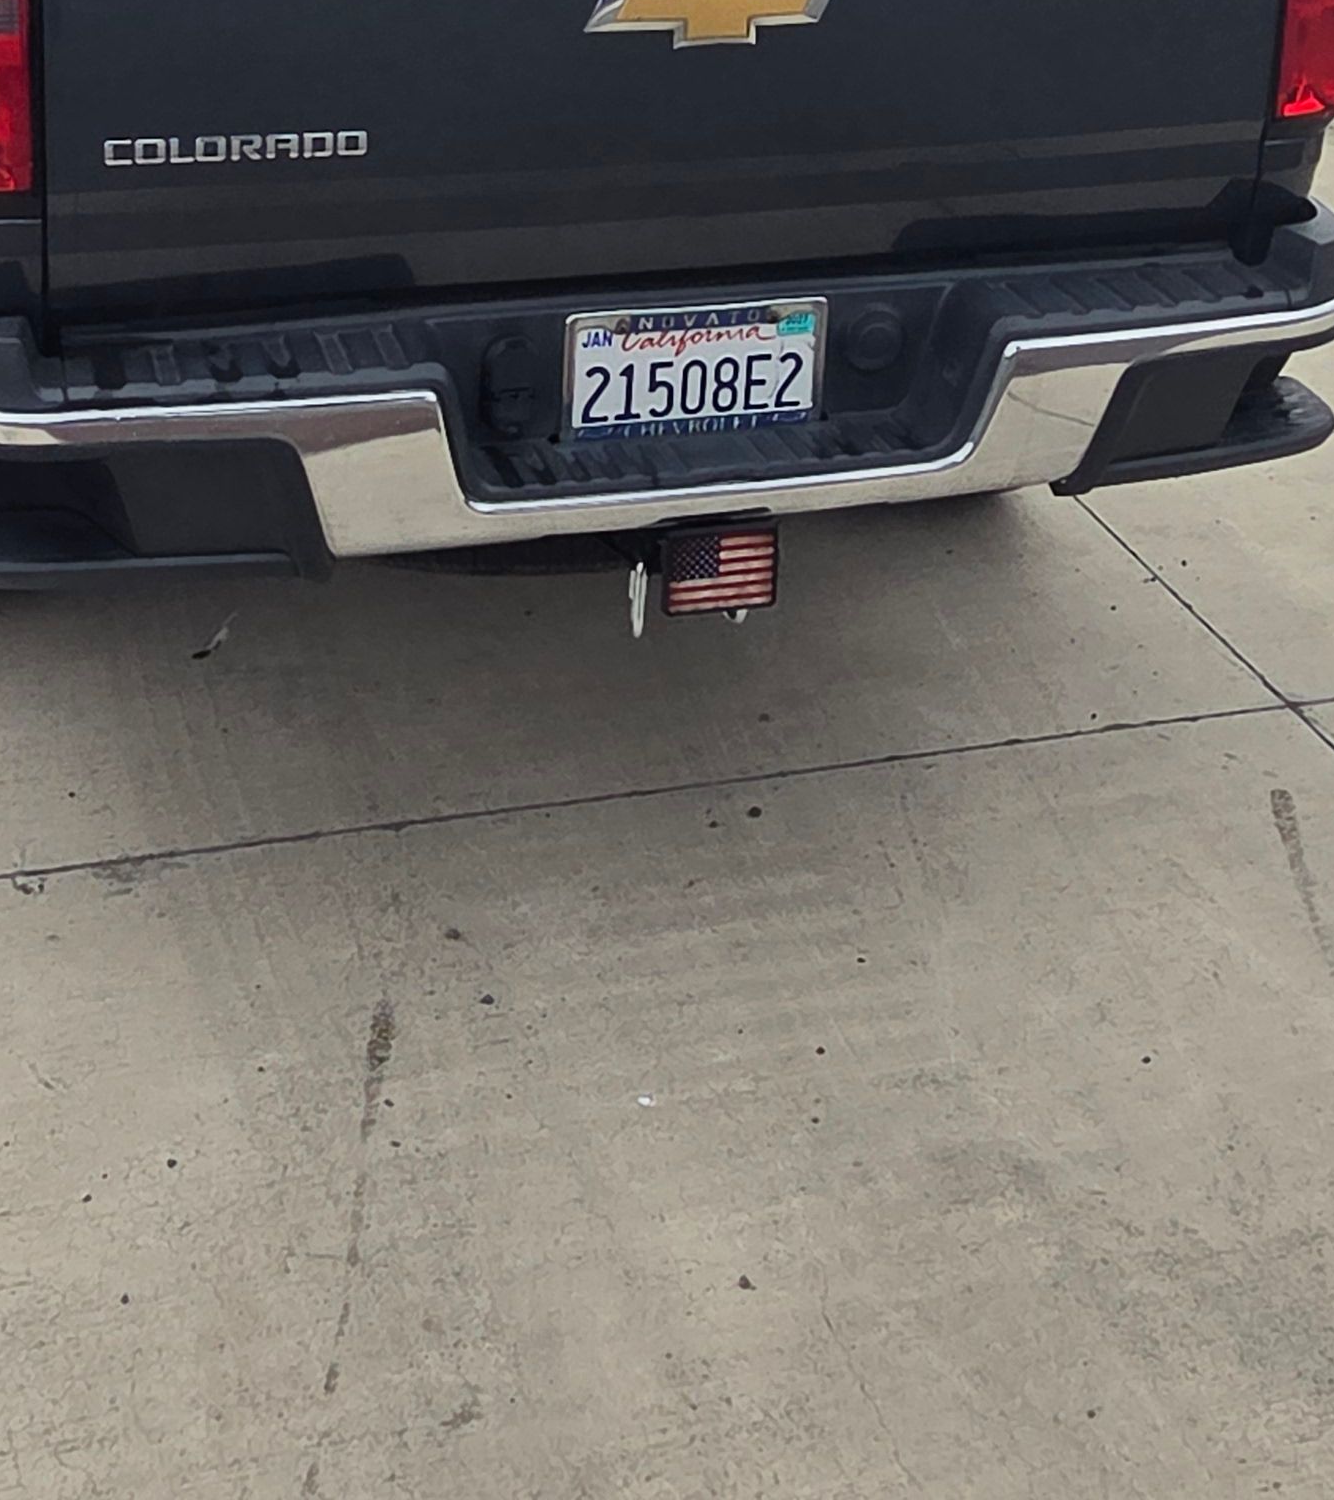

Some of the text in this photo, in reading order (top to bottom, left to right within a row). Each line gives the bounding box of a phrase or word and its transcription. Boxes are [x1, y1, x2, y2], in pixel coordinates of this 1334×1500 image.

[103, 130, 369, 167] COLORADO
[637, 311, 761, 330] NOVATO
[581, 328, 613, 349] JAN
[620, 325, 776, 357] California
[580, 352, 805, 425] 21508E2
